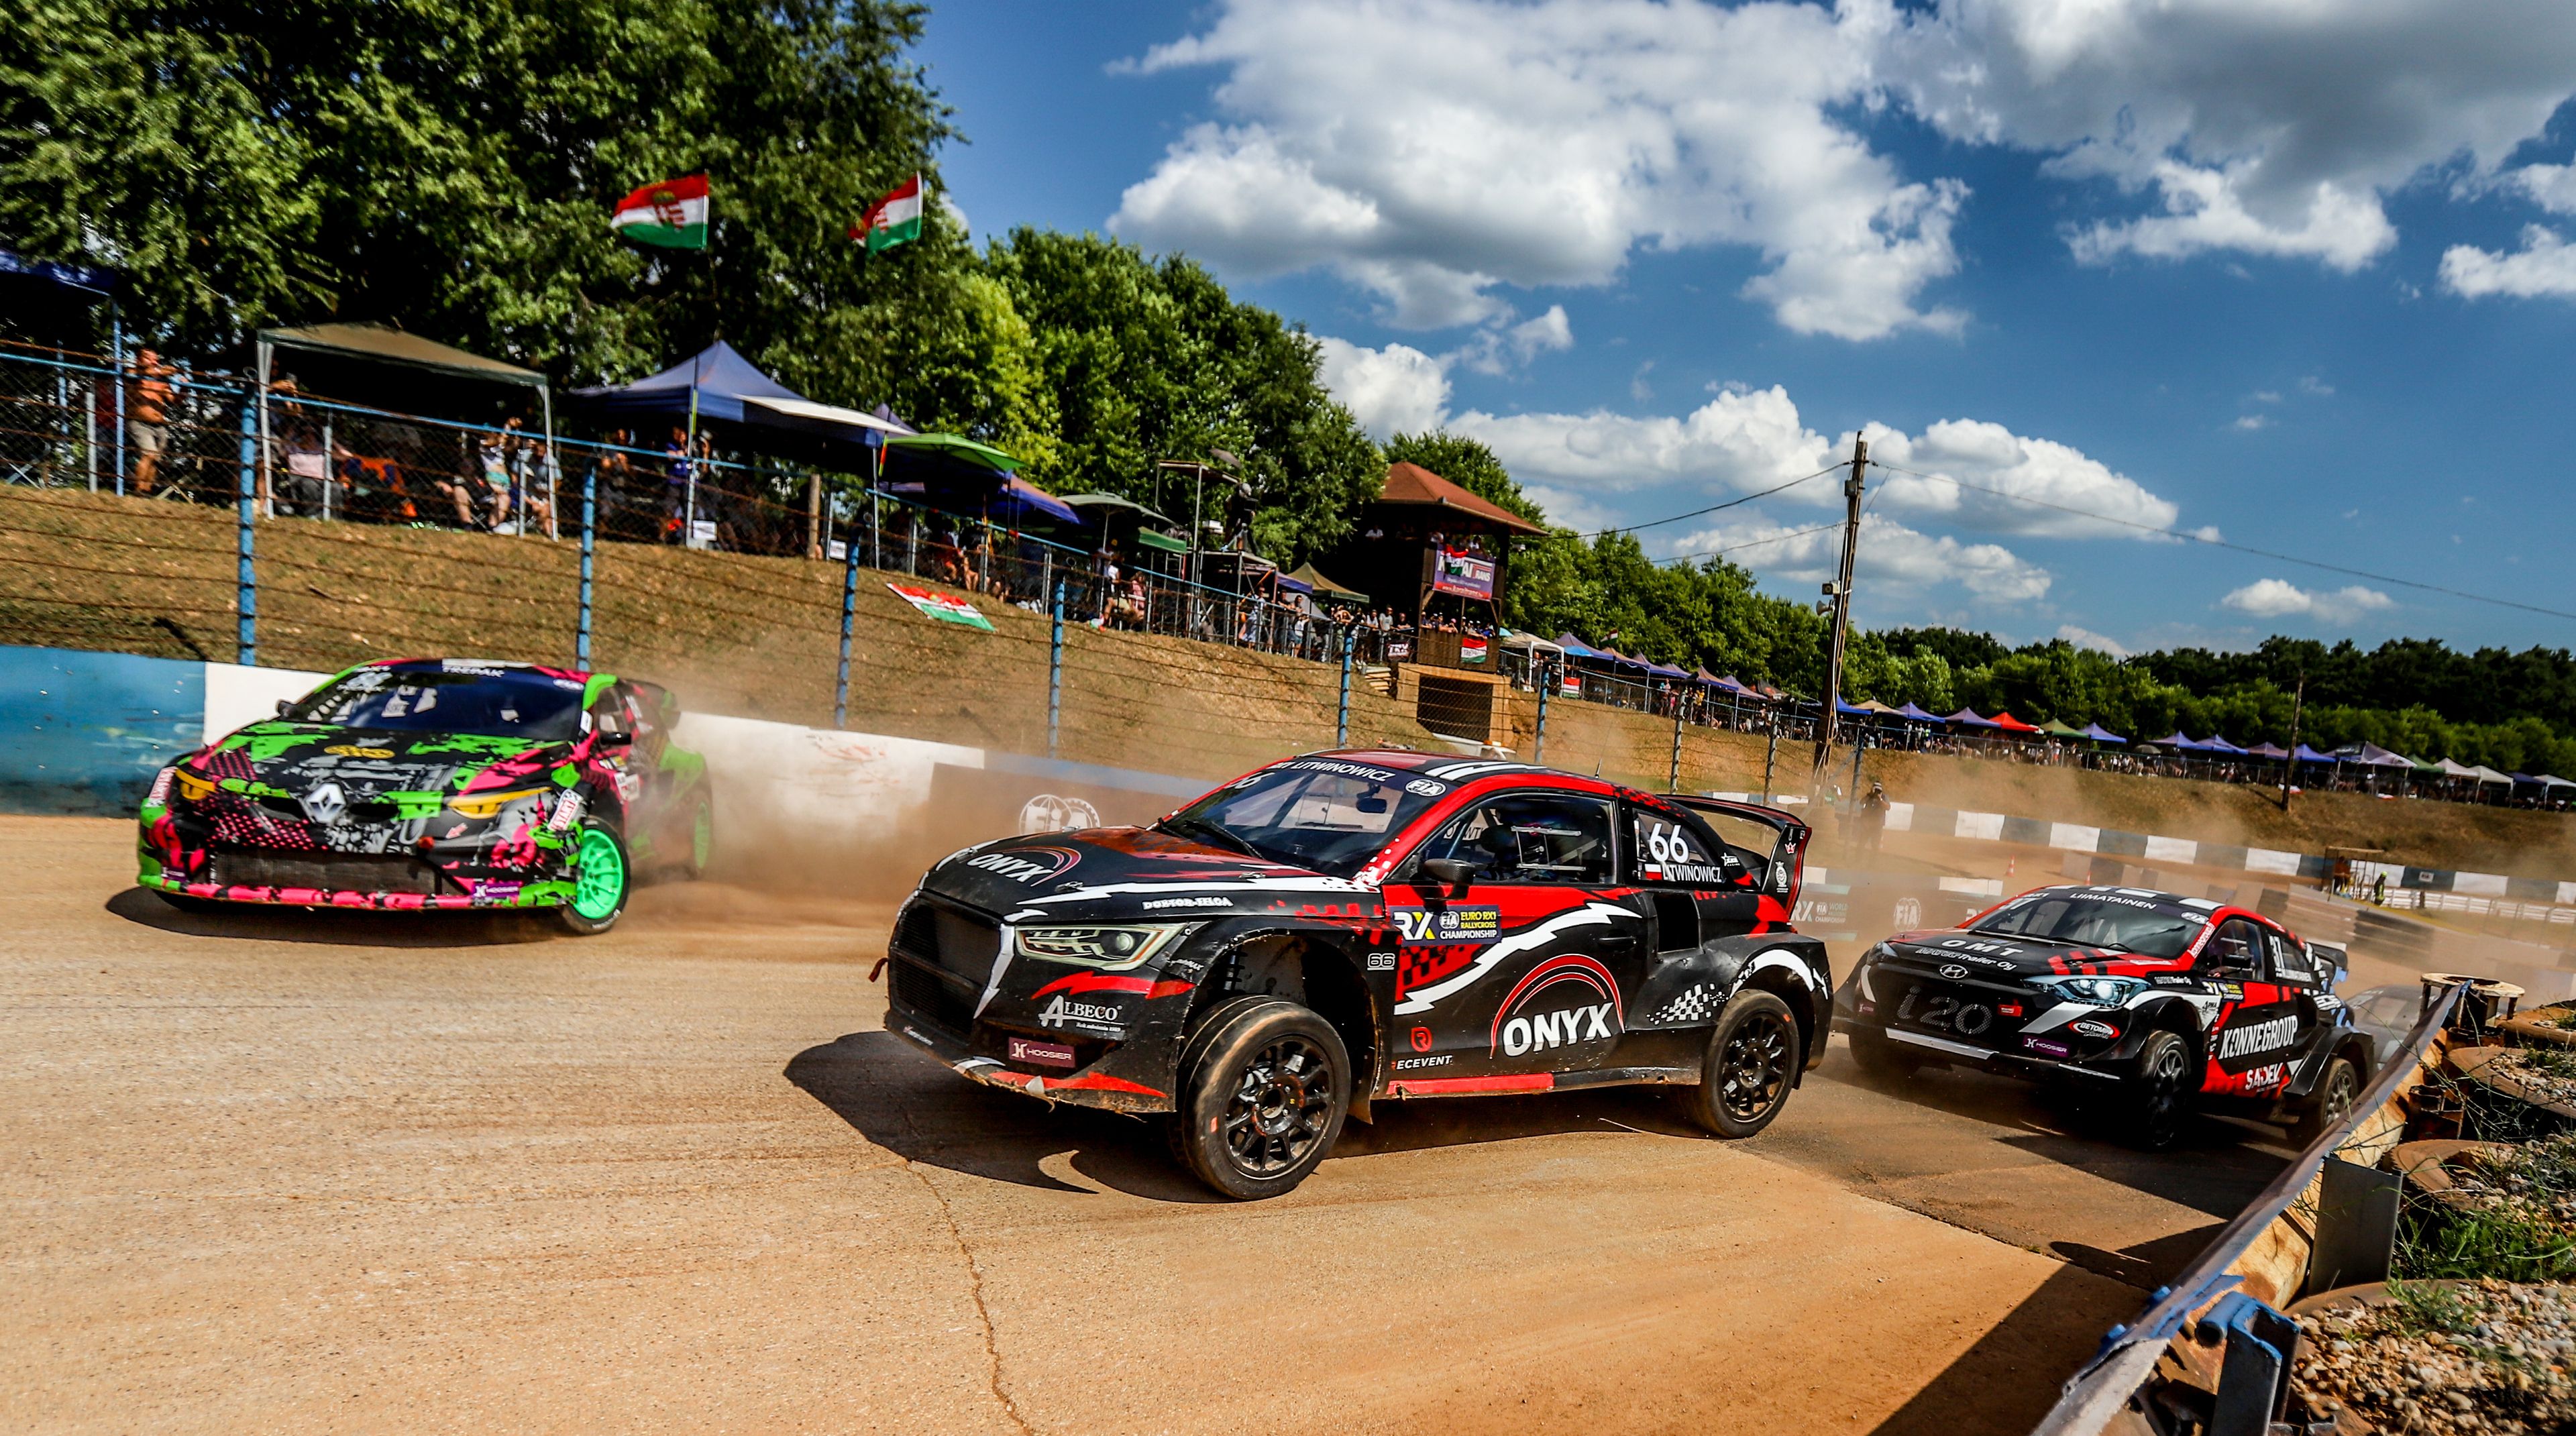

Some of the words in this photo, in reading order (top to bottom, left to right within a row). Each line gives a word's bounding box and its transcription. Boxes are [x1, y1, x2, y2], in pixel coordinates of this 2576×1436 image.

[1291, 761, 1395, 782] LITWINOWICZ
[1409, 779, 1441, 795] FIA
[1650, 823, 1689, 863] 66
[967, 853, 1054, 883] ONYX
[1790, 901, 1813, 922] RX
[2070, 893, 2157, 909] LIIMATAINEN
[1895, 904, 1918, 925] FIA
[1394, 912, 1436, 940] RX
[1460, 912, 1481, 921] EURO
[1483, 911, 1497, 920] RX1
[1440, 930, 1497, 940] CHAMPIONSHIP
[1941, 939, 2023, 956] OMT
[1368, 954, 1395, 968] 66
[1997, 960, 2017, 971] Oy
[1038, 995, 1118, 1028] ALBECO
[1897, 985, 1992, 1034] i20
[1503, 1002, 1613, 1057] ONYX
[2218, 1015, 2298, 1060] KONNEGROUP
[1027, 1050, 1072, 1060] HOOSIER
[2035, 1043, 2068, 1052] HOOSIER
